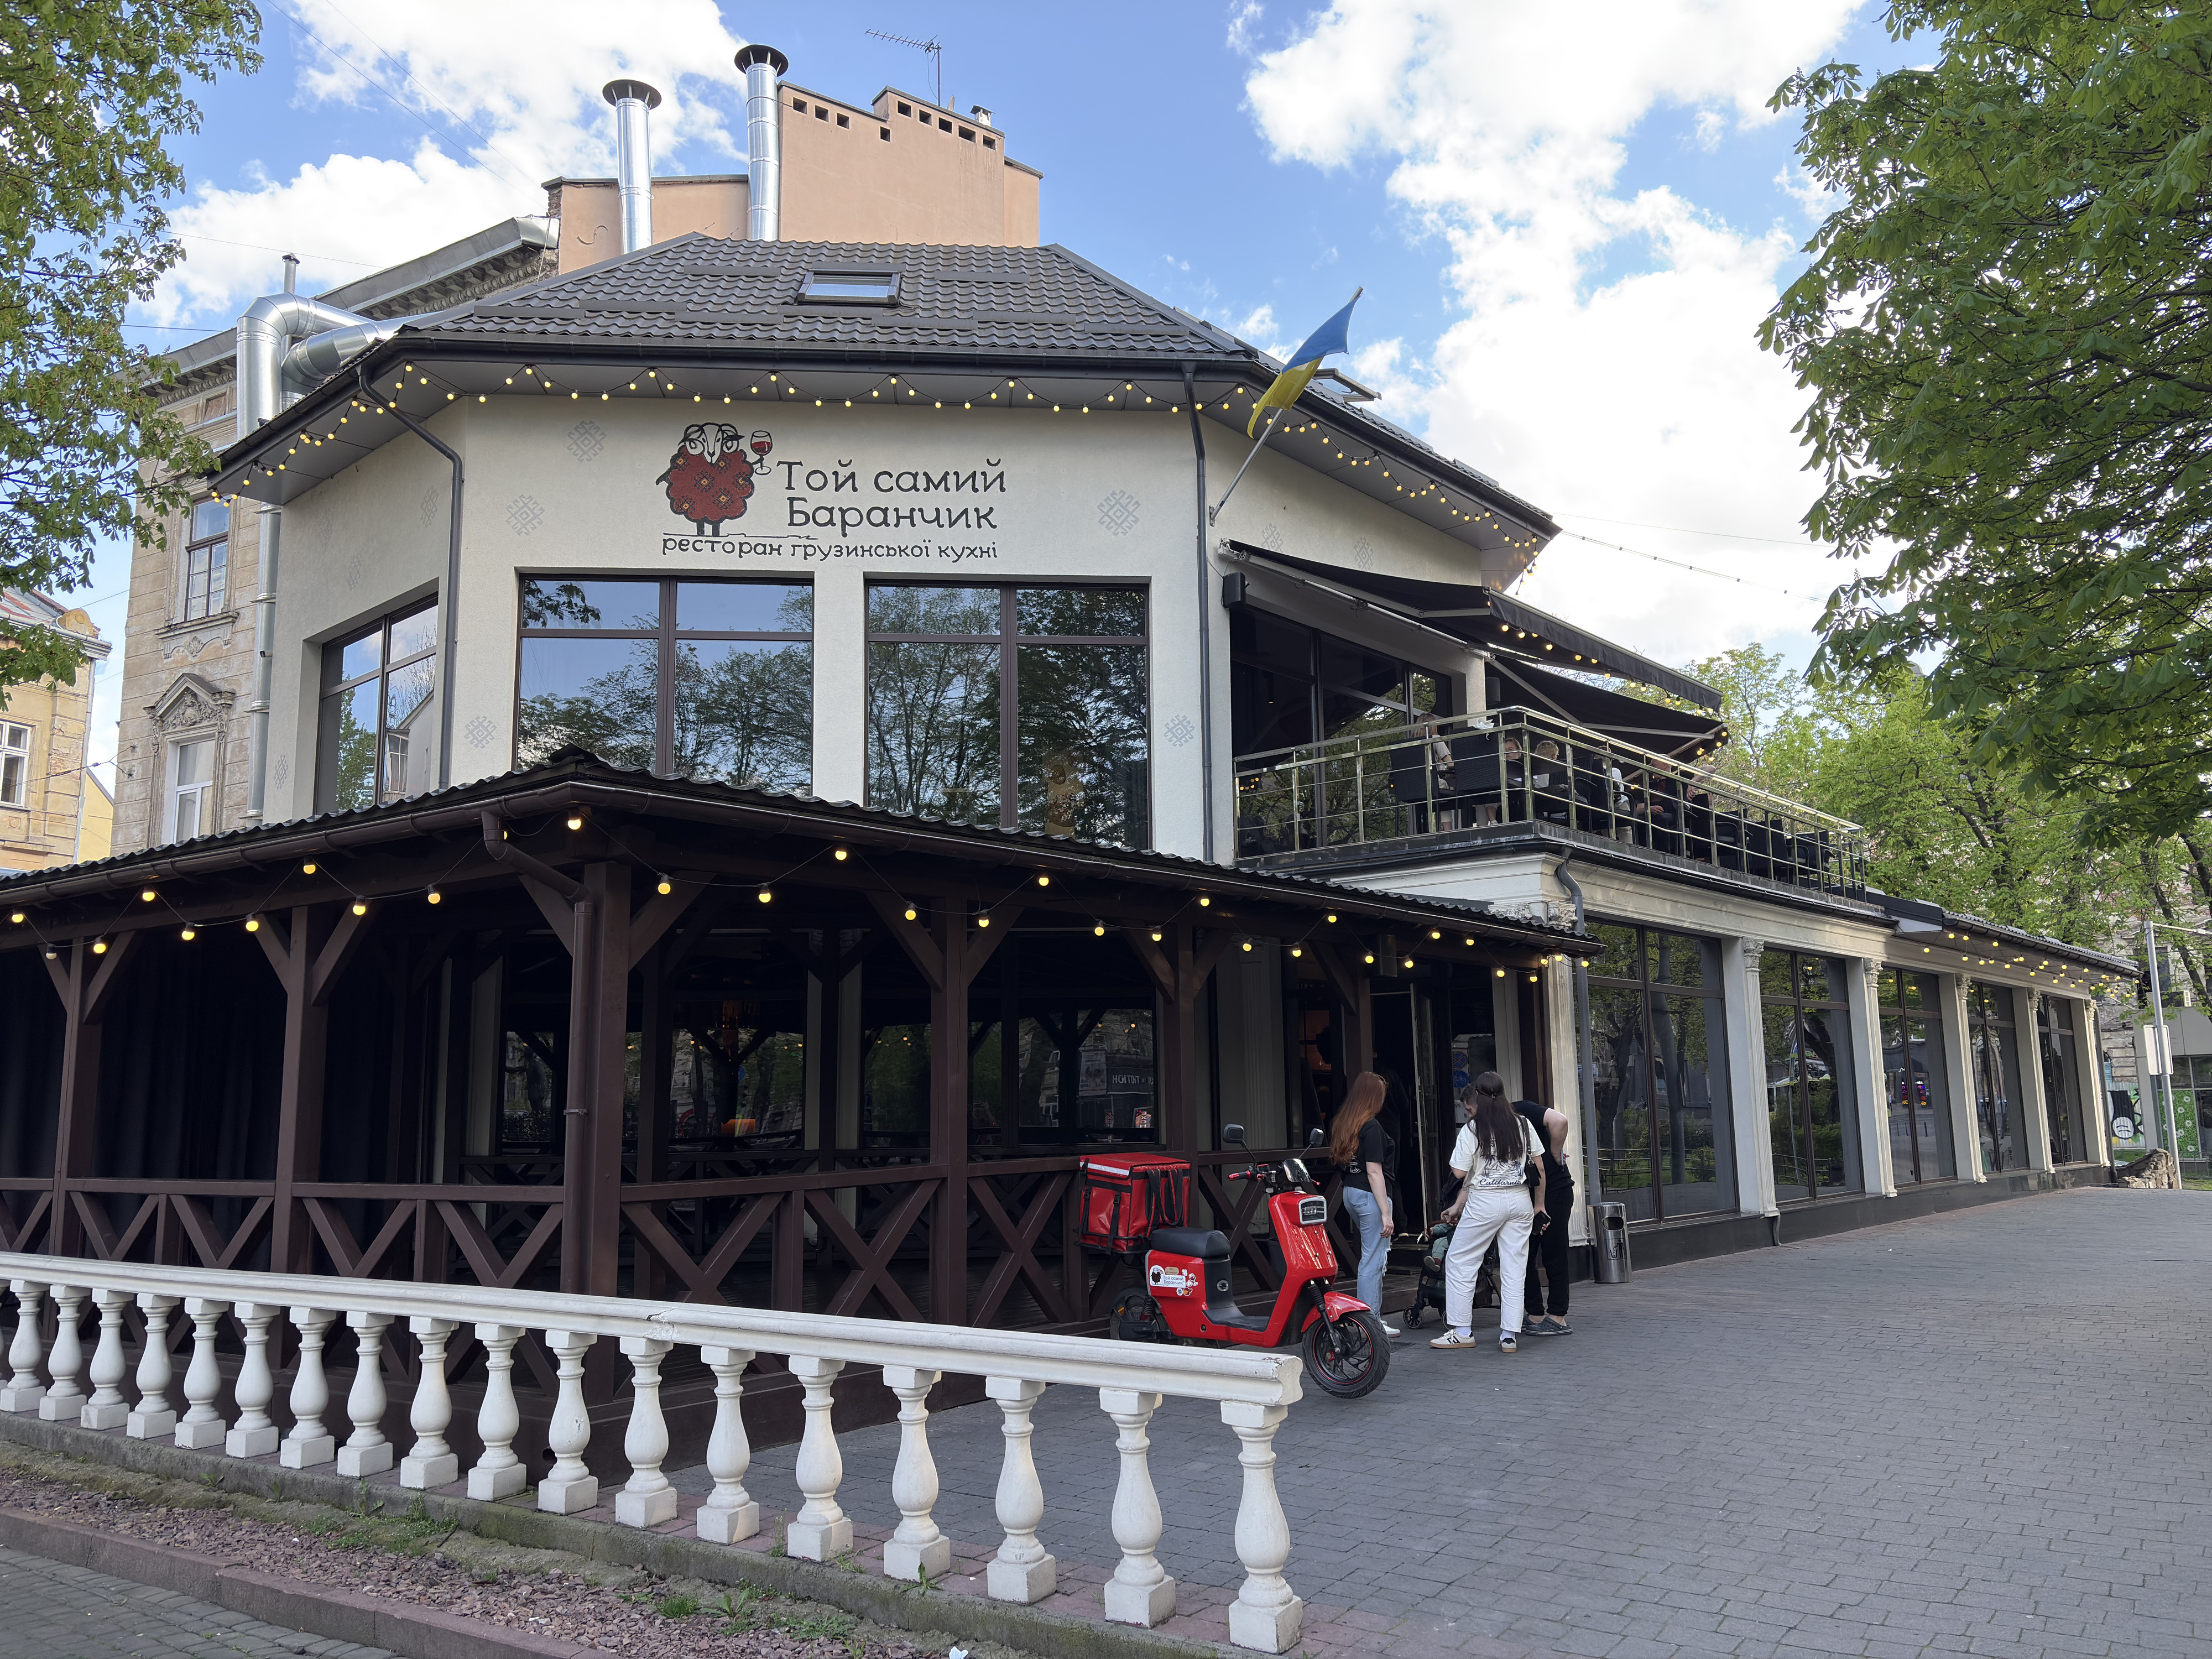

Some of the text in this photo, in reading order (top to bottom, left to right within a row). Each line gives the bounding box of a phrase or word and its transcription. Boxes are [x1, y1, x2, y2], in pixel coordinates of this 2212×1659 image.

[776, 458, 1006, 493] Той самий
[786, 497, 998, 538] Баранчик
[662, 536, 998, 563] ресторан грузинської кухні
